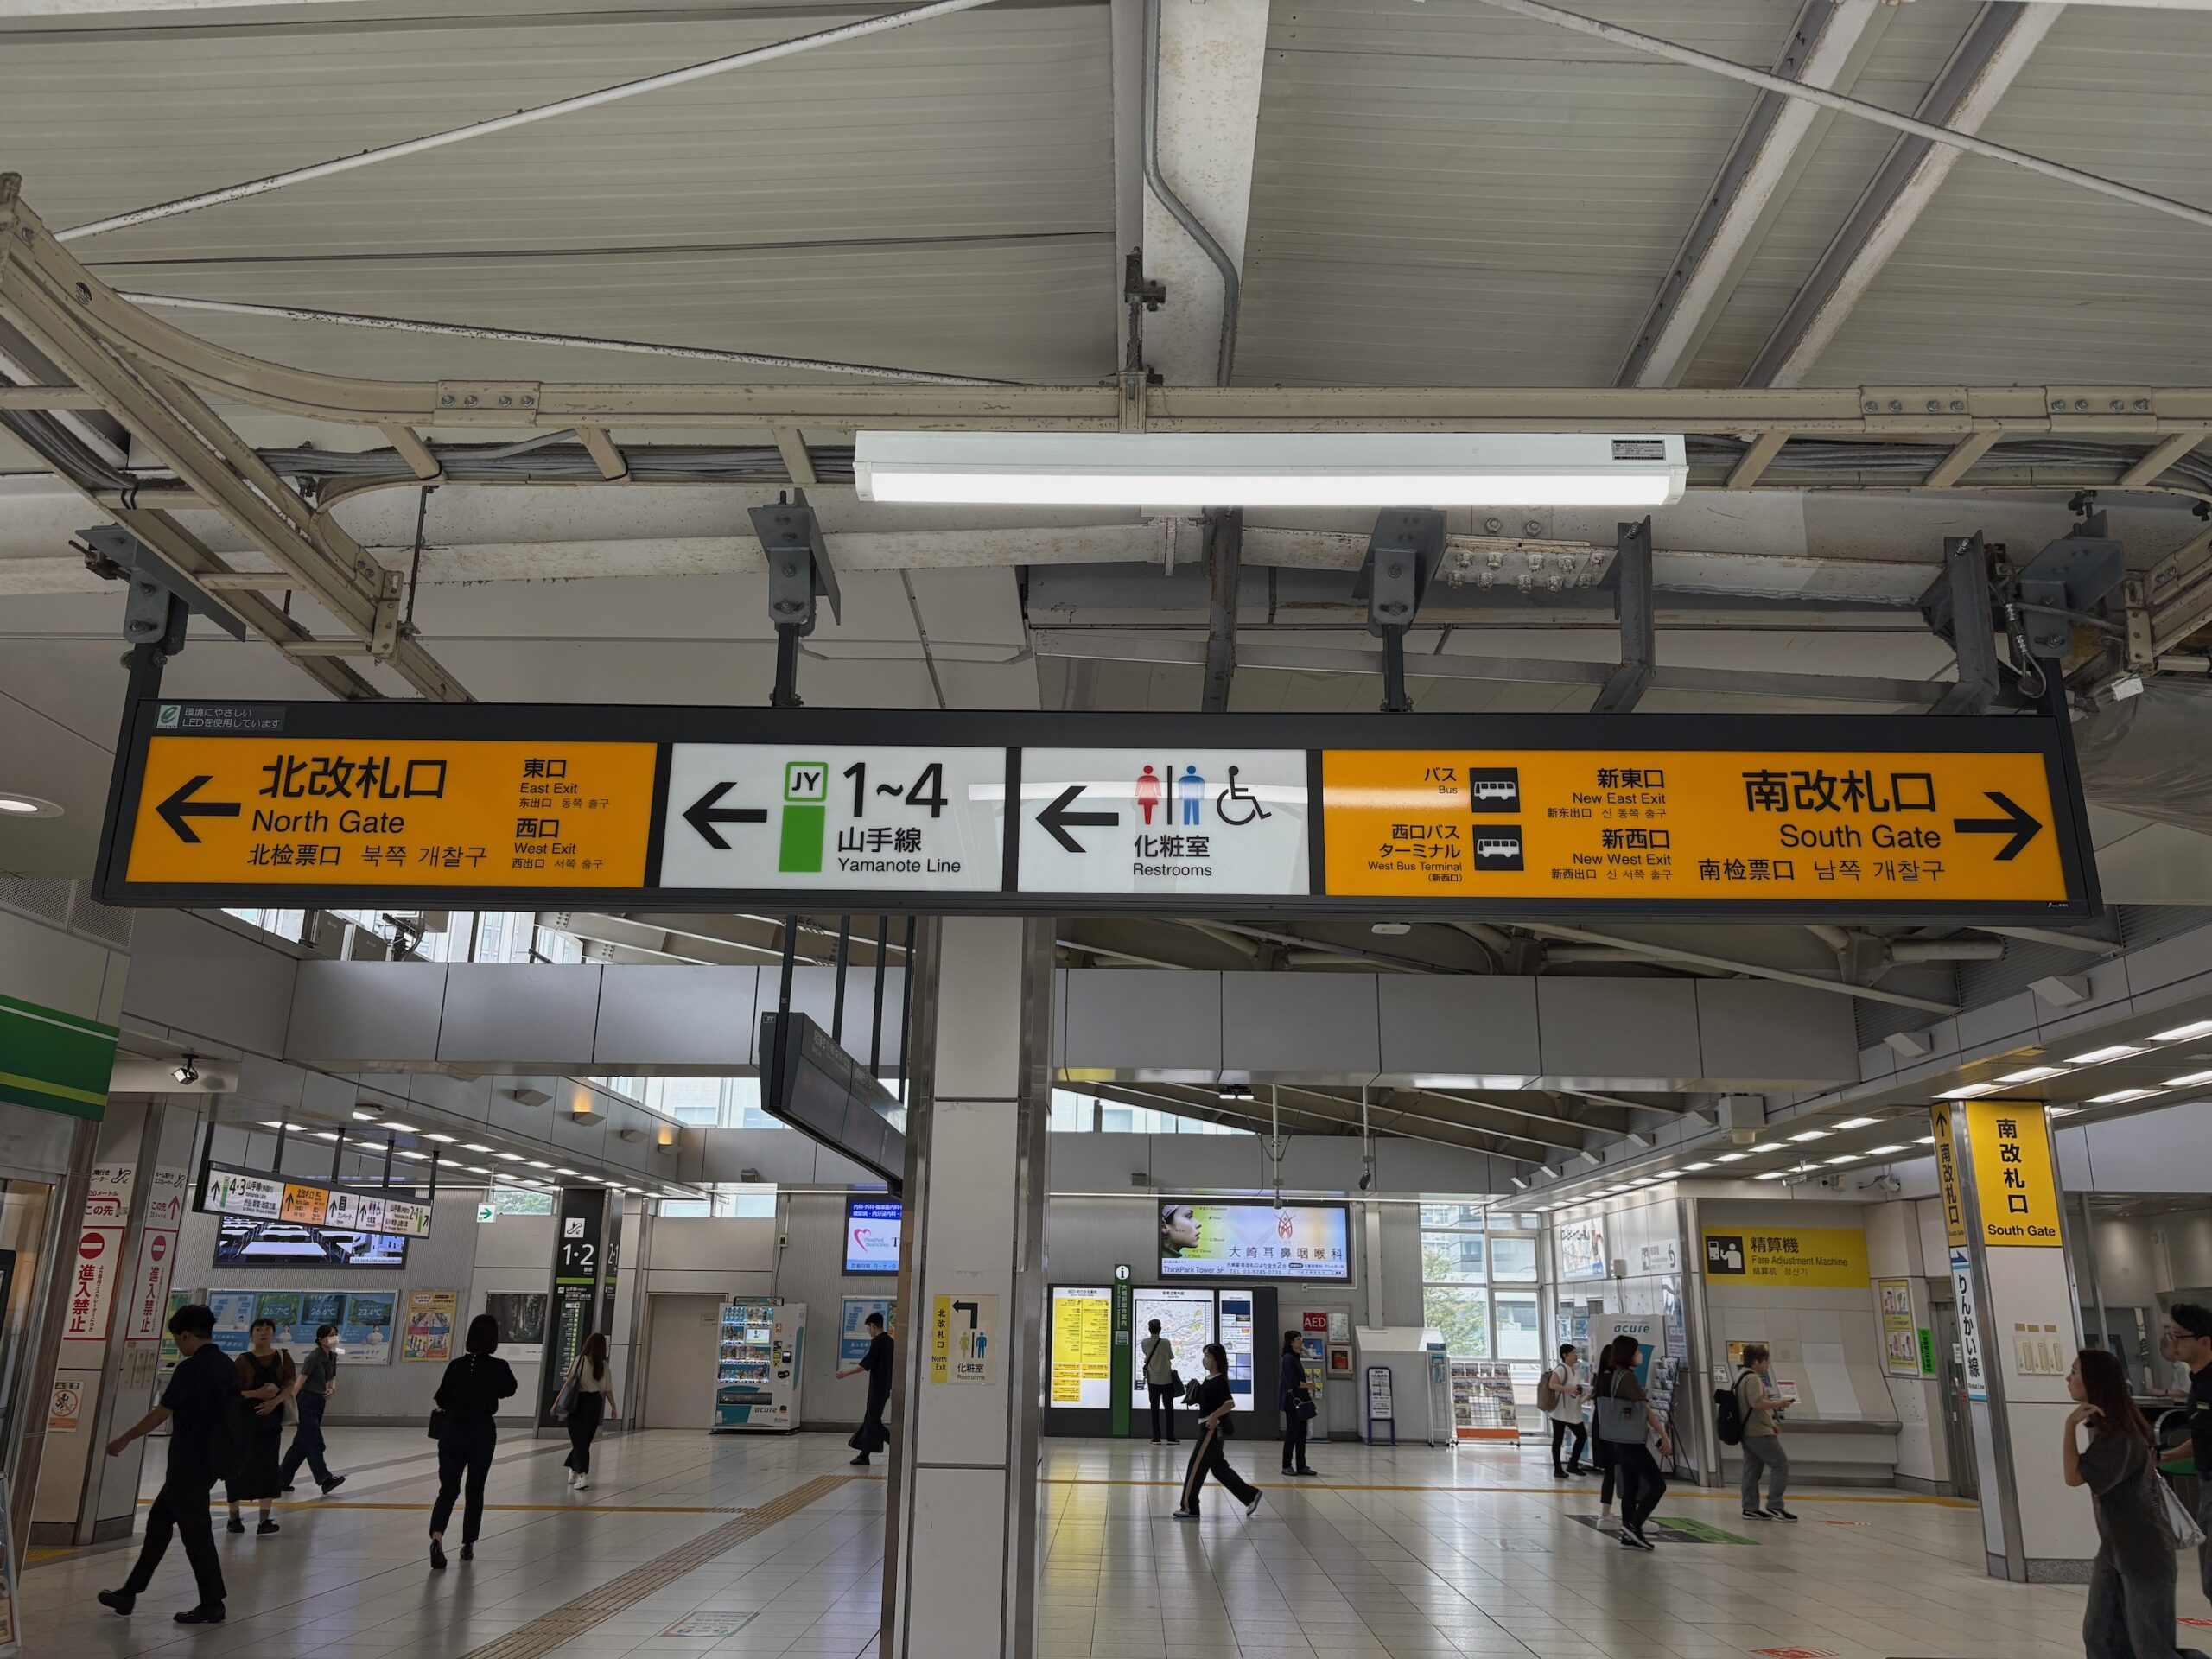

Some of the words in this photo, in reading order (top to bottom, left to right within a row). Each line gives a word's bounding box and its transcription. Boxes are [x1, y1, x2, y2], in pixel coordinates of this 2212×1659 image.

[184, 708, 252, 717] 環境にやさしい
[182, 718, 280, 728] LEDを使用しています
[523, 758, 567, 779] 東口
[1424, 767, 1457, 781] バス
[258, 754, 447, 799] 北改札口
[791, 772, 821, 791] JY
[1597, 768, 1665, 788] 新東口
[520, 782, 550, 794] East
[554, 783, 578, 794] Exit
[1438, 785, 1458, 794] Bus
[1742, 769, 1936, 813] 南改札口
[519, 798, 552, 808] 东出口
[562, 798, 582, 809] 동쪽
[588, 798, 609, 809] 출구
[1573, 792, 1602, 804] New
[1607, 792, 1637, 804] East
[1642, 793, 1666, 804] Exit
[1548, 808, 1592, 818] 新东出口
[252, 810, 327, 834] North
[339, 811, 404, 835] Gate
[516, 817, 559, 838] 西口
[1392, 824, 1459, 839] 西口バス
[1602, 828, 1670, 849] 新西口
[1779, 823, 1862, 848] South
[1872, 824, 1941, 849] Gate
[837, 827, 922, 853] 山手線
[1134, 835, 1210, 858] 化粧室
[247, 843, 341, 867] 北检票口
[360, 844, 407, 868] 북쪽
[417, 845, 487, 868] 개찰구
[514, 842, 547, 854] West
[552, 843, 576, 855] Exit
[1379, 843, 1460, 859] ターミナル
[512, 858, 545, 868] 西出口
[555, 859, 576, 869] 서쪽
[582, 859, 603, 869] 출구
[838, 857, 921, 873] Yamanote
[927, 858, 961, 873] Line
[1368, 861, 1394, 870] West
[1397, 861, 1416, 871] Bus
[1419, 861, 1462, 871] Terminal
[1573, 853, 1602, 864] New
[1607, 853, 1642, 865] West
[1647, 853, 1672, 865] Exit
[1133, 862, 1212, 876] Restrooms
[1551, 868, 1597, 880] 新西出口
[1697, 858, 1795, 881] 南检票口
[1815, 860, 1862, 881] 남쪽
[1873, 860, 1946, 881] 개찰구
[1996, 1118, 2029, 1214] 南改札口
[1940, 1143, 1959, 1224] 南改札口
[85, 1205, 113, 1216] この先
[151, 1202, 167, 1211] この先
[1987, 1224, 2024, 1236] South
[2027, 1224, 2056, 1237] Gate
[1229, 1245, 1342, 1260] 大崎耳鼻咽喉科
[1750, 1236, 1799, 1254] 精算機
[1751, 1255, 1770, 1264] Fare
[1771, 1255, 1814, 1267] Adjustment
[1815, 1256, 1847, 1267] Machine
[69, 1264, 96, 1332] 進入禁止
[140, 1265, 159, 1332] 進入禁止
[937, 1308, 946, 1349] 北改札口
[1304, 1316, 1327, 1328] AED
[1614, 1325, 1650, 1333] acure
[1959, 1274, 1980, 1377] りんかい線
[957, 1363, 984, 1373] 化粧室
